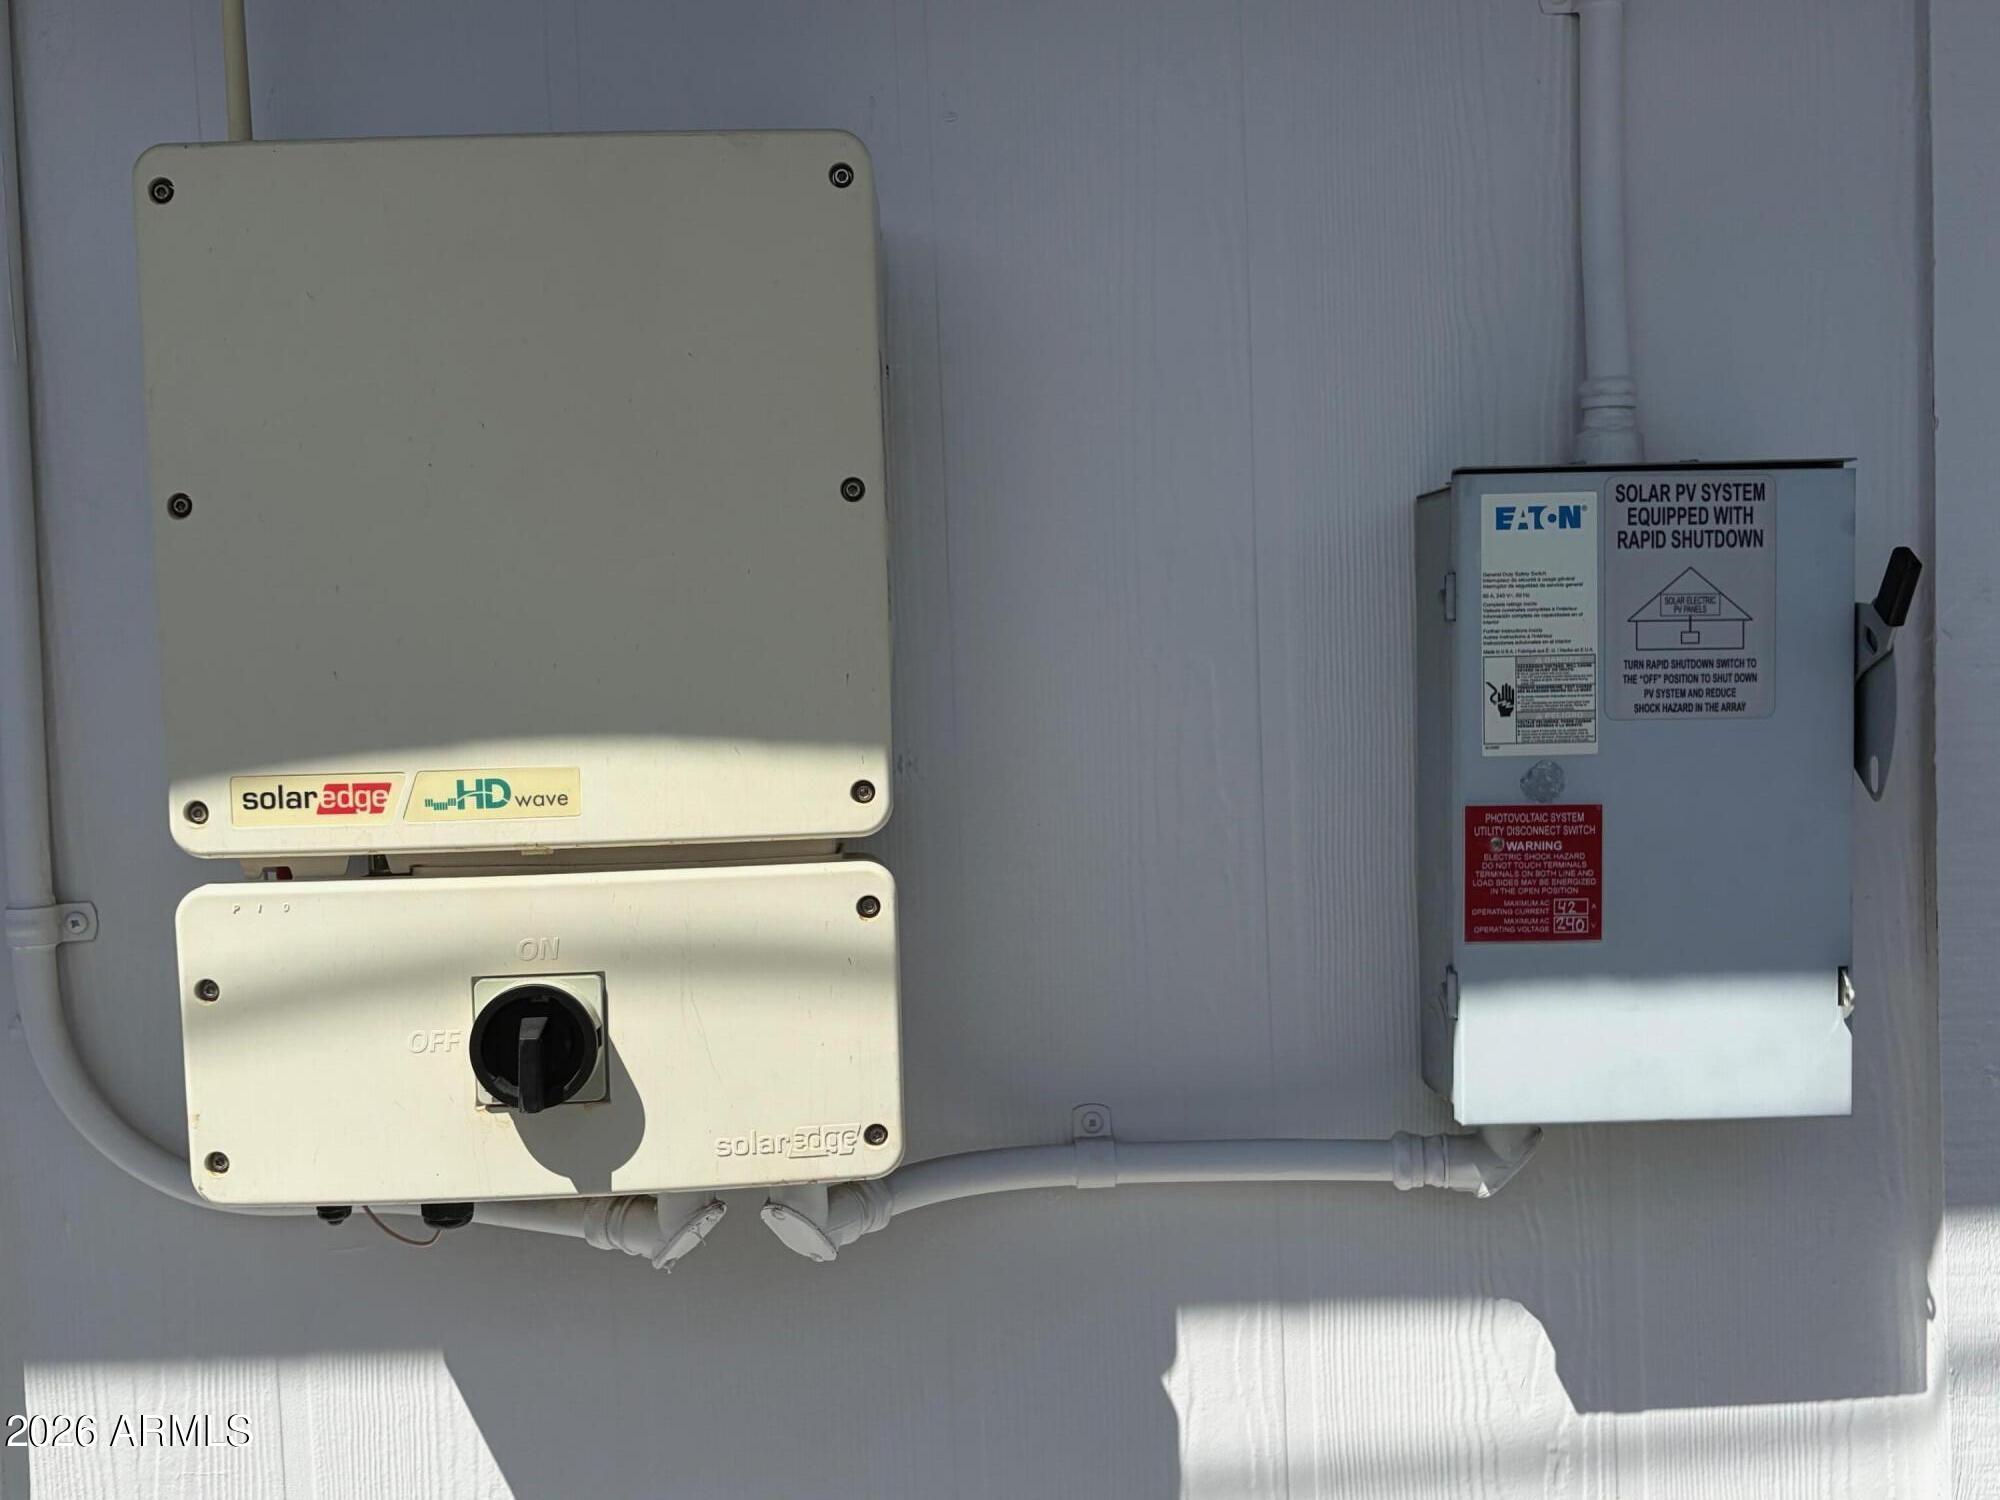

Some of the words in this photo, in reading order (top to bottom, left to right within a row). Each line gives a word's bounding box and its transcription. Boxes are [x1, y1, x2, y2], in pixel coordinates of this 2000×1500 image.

[1615, 484, 1670, 502] SOLAR
[1676, 484, 1696, 501] PV
[1701, 483, 1765, 501] SYSTEM
[1496, 505, 1581, 530] EATON
[1628, 507, 1709, 526] EQUIPPED
[1714, 506, 1753, 524] WITH
[1617, 530, 1666, 549] RAPID
[1671, 529, 1763, 548] SHUTDOWN
[1665, 597, 1684, 605] SOLAR
[1687, 596, 1716, 604] ELECTRIC
[1624, 660, 1644, 670] TURN
[1646, 660, 1668, 669] RAPID
[1671, 659, 1714, 669] SHUTDOWN
[1716, 658, 1744, 668] SWITCH
[1747, 658, 1756, 668] TO
[1623, 675, 1637, 684] THE
[1664, 674, 1698, 683] POSITION
[1701, 673, 1710, 682] TO
[1713, 673, 1732, 682] SHUT
[1734, 673, 1757, 682] DOWN
[1644, 689, 1654, 698] PV
[1656, 689, 1686, 698] SYSTEM
[1688, 688, 1704, 697] AND
[1706, 688, 1736, 697] REDUCE
[1634, 703, 1660, 714] SHOCK
[1662, 703, 1693, 713] HAZARD
[1696, 703, 1703, 712] IN
[1705, 702, 1719, 712] THE
[1721, 702, 1746, 712] ARRAY
[242, 784, 390, 815] solaredge
[456, 778, 512, 809] HD
[515, 791, 569, 808] wave
[1485, 813, 1548, 823] PHOTOVOLTAIC
[1551, 812, 1584, 822] SYSTEM
[1474, 826, 1504, 836] UTILITY
[1507, 826, 1561, 836] DISCONNECT
[1564, 825, 1595, 835] SWITCH
[1506, 841, 1562, 851] WARNING
[1476, 870, 1519, 878] TERMINALS
[1558, 901, 1576, 914] 42
[1474, 926, 1516, 934] OPERATING
[1556, 918, 1585, 932] 240
[519, 936, 560, 961] ON
[408, 1029, 461, 1054] OFF
[717, 1125, 858, 1157] solaredge
